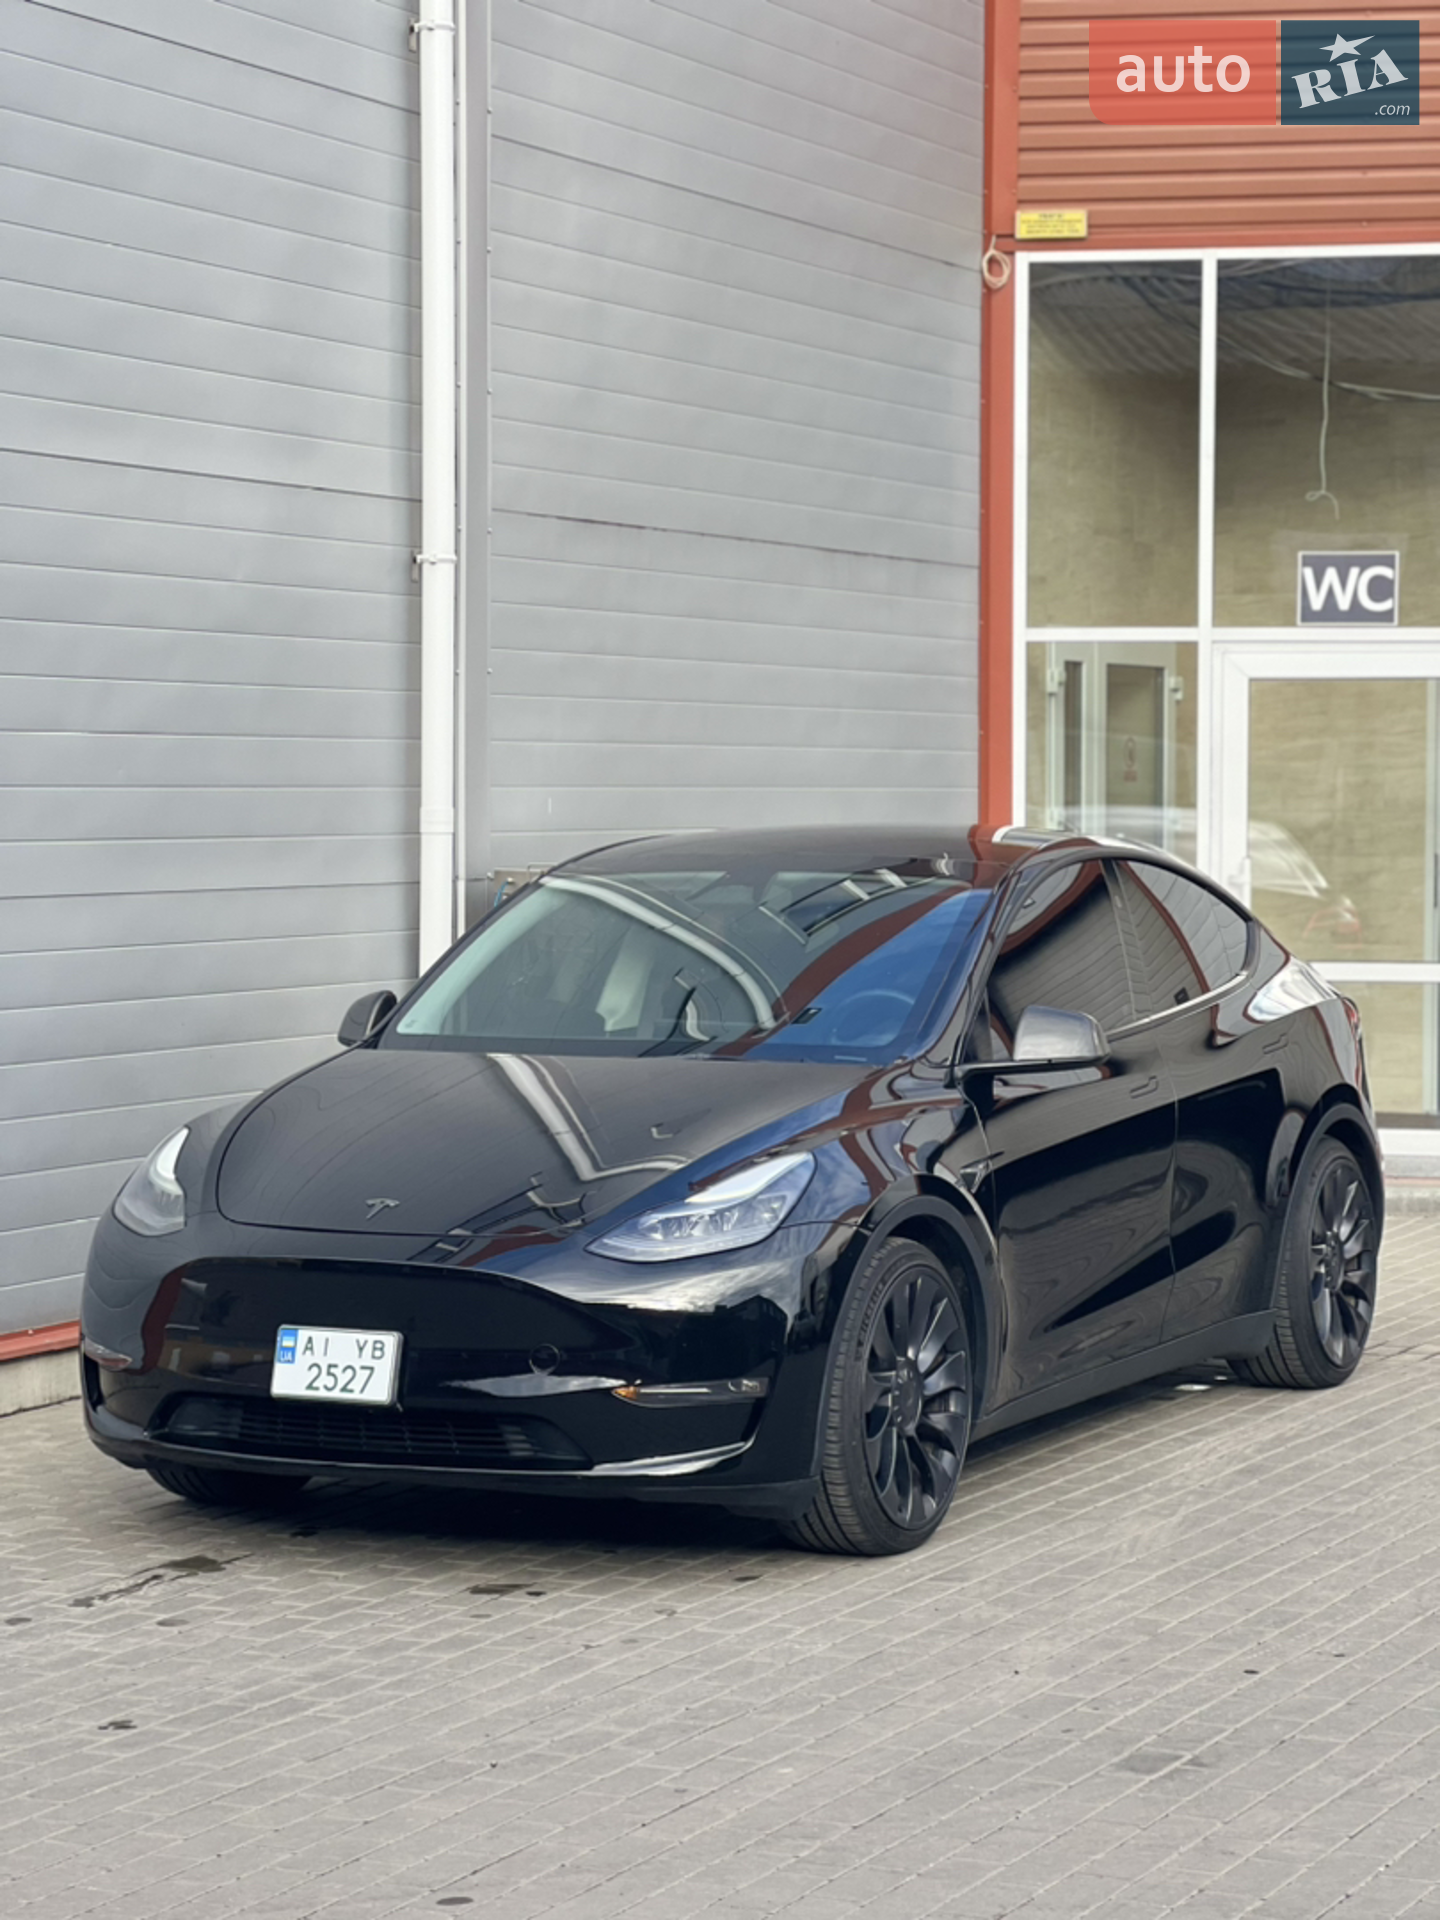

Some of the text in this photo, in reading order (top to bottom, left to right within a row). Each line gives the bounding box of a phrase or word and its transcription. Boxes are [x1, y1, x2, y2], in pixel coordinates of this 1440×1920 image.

[1302, 565, 1395, 613] WC
[280, 1350, 294, 1363] UA
[302, 1336, 386, 1361] AI YB
[305, 1362, 376, 1395] 2527
